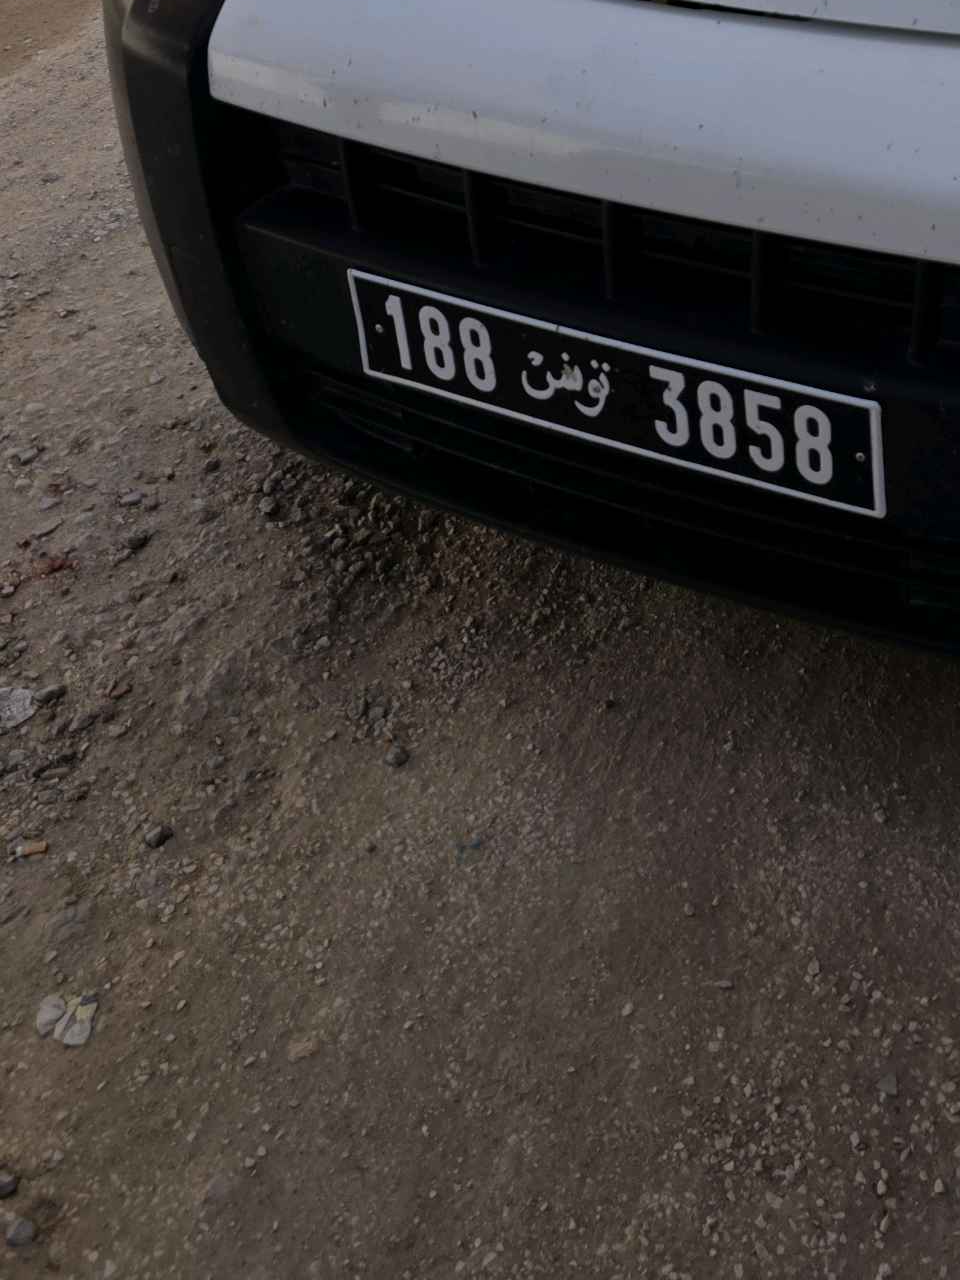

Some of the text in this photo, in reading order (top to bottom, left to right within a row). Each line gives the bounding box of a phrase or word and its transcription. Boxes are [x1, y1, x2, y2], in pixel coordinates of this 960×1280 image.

[384, 294, 834, 486] 188 تونس 3858
